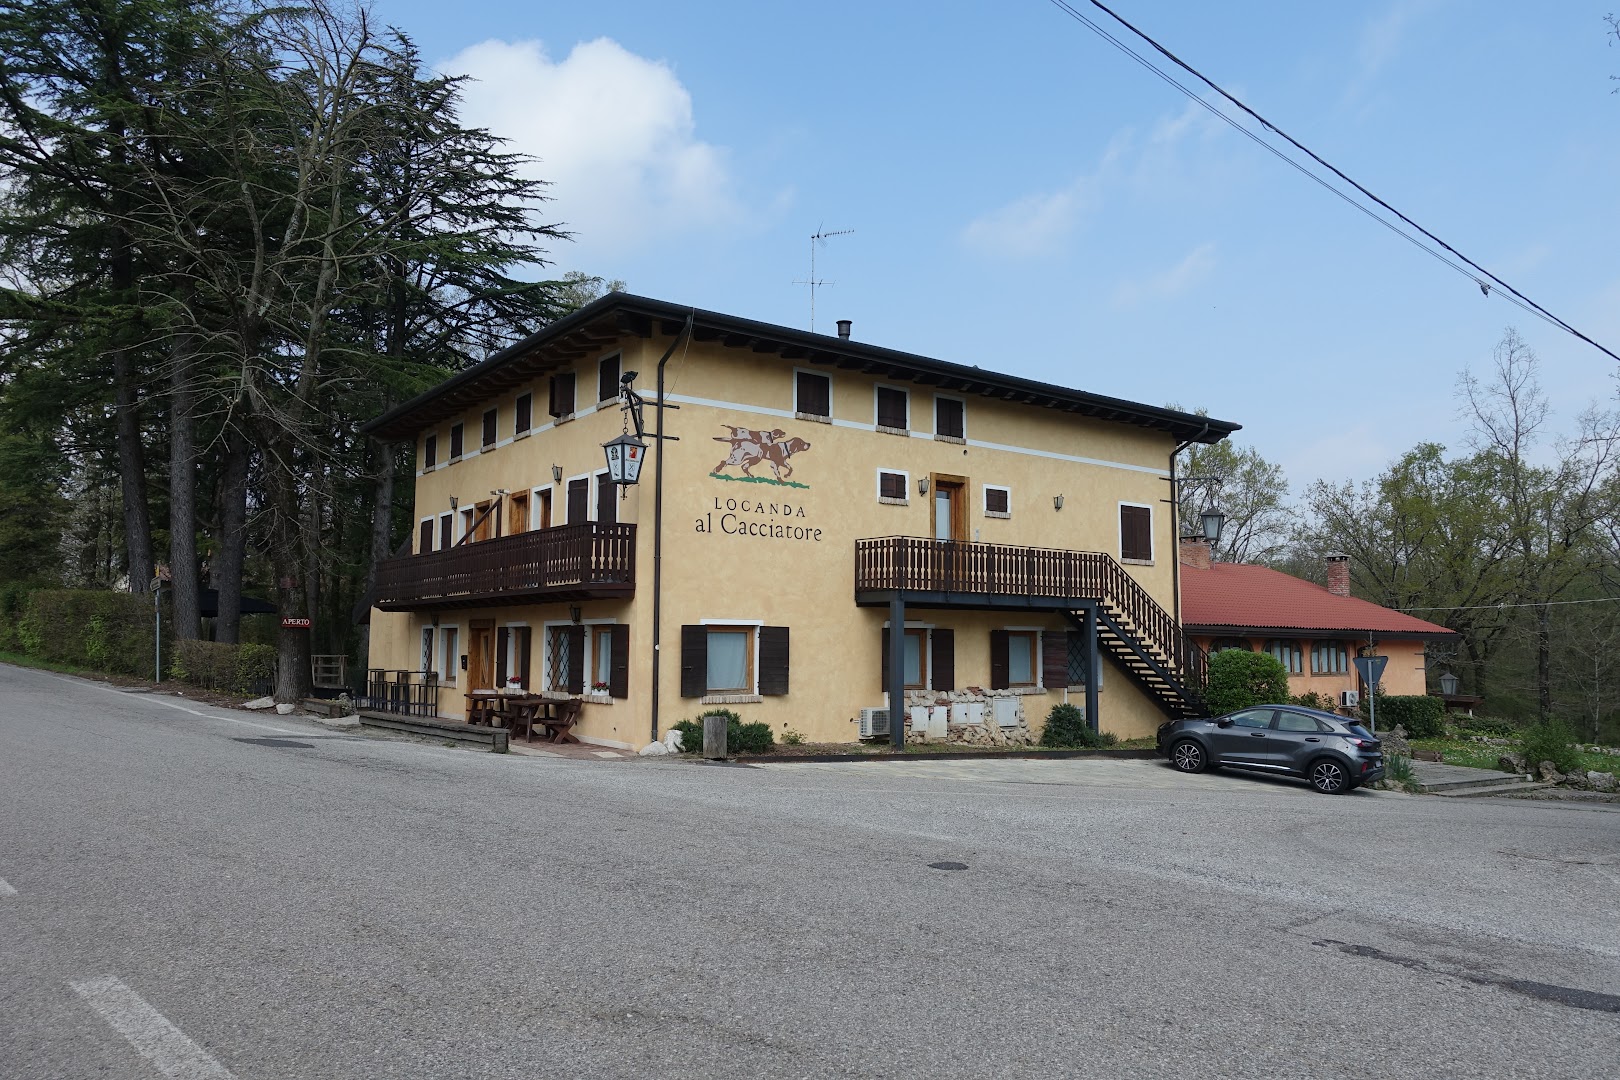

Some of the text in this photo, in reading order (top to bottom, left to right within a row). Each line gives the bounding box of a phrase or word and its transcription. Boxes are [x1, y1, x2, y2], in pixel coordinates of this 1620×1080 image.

[714, 497, 805, 518] LOCANDA
[695, 512, 822, 541] al Cacciatore
[282, 618, 310, 626] APERTO
